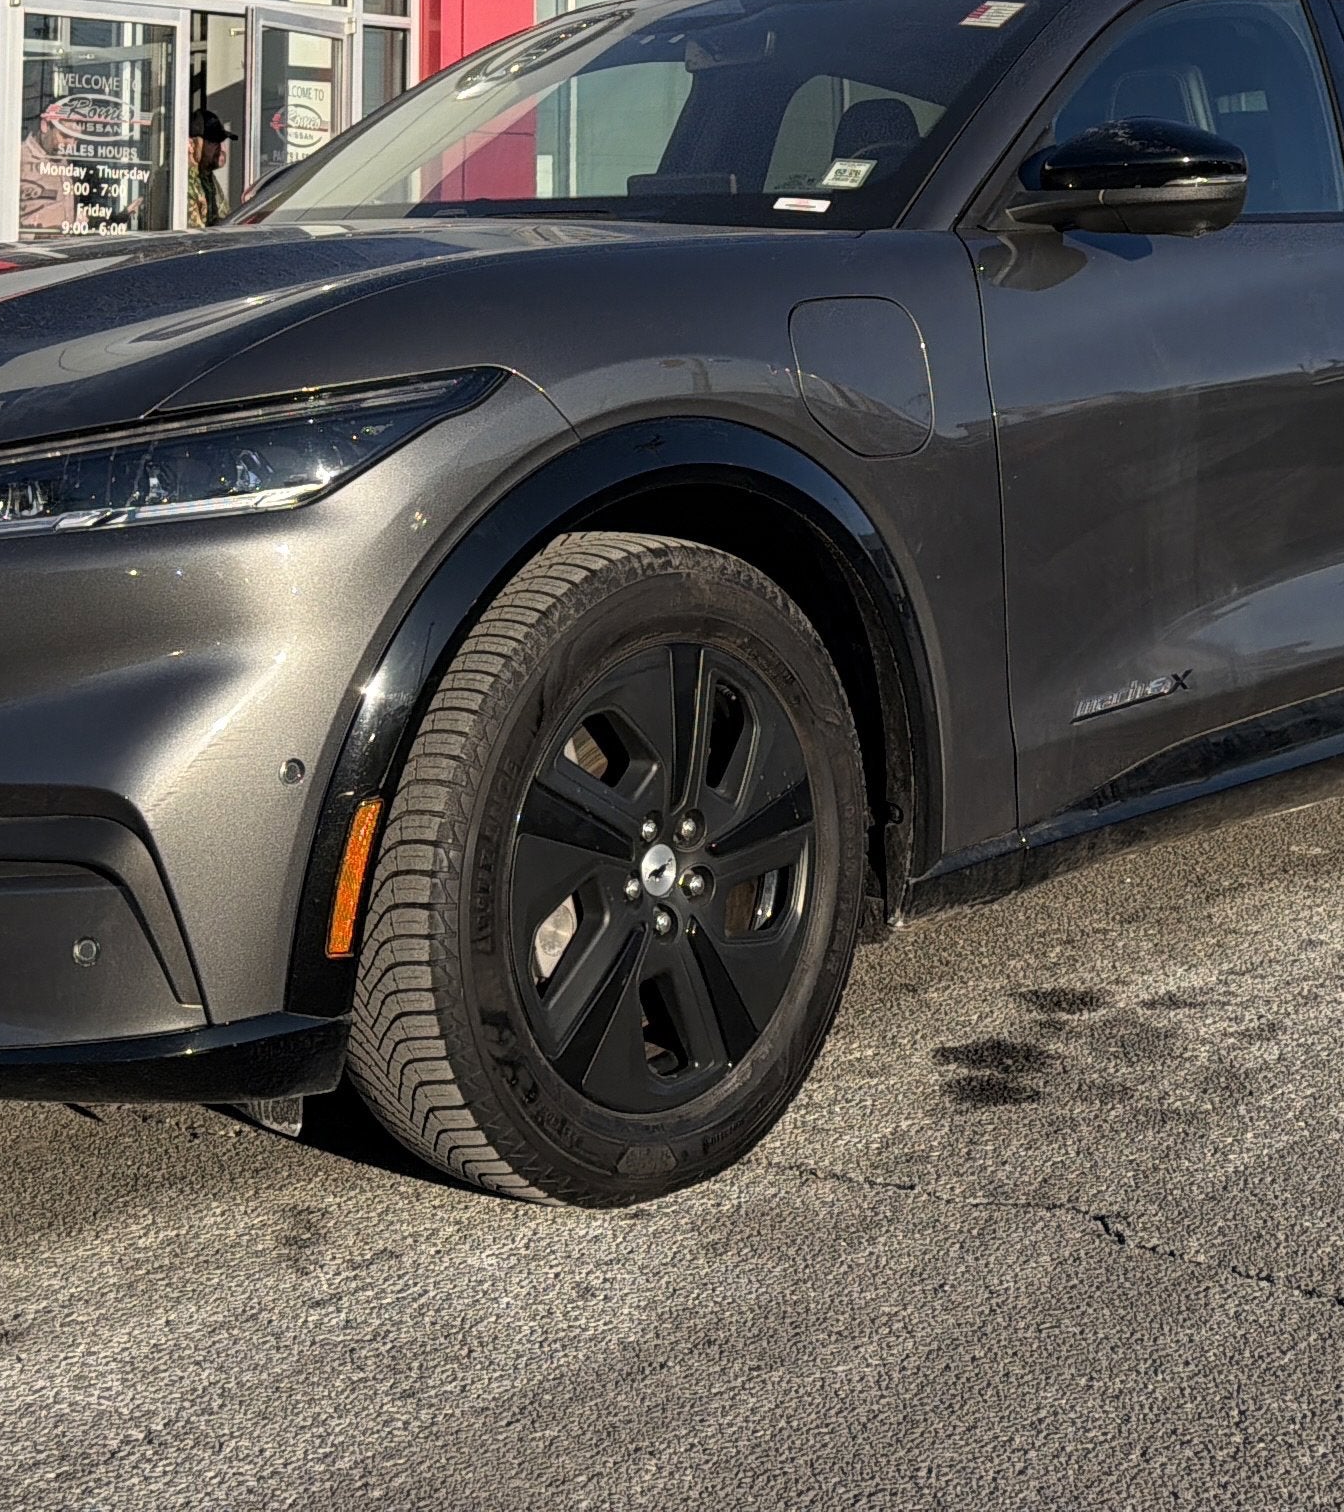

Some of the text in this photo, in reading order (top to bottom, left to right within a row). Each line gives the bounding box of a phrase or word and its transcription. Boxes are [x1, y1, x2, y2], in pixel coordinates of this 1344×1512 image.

[314, 89, 325, 101] TO
[57, 143, 138, 159] SALES HOURS
[39, 162, 87, 180] Monday
[97, 165, 150, 183] Thursday
[62, 182, 90, 196] 9:00
[100, 183, 127, 197] 7:00
[76, 203, 113, 220] Friday
[61, 221, 89, 235] 9:00
[99, 222, 127, 236] 6:00
